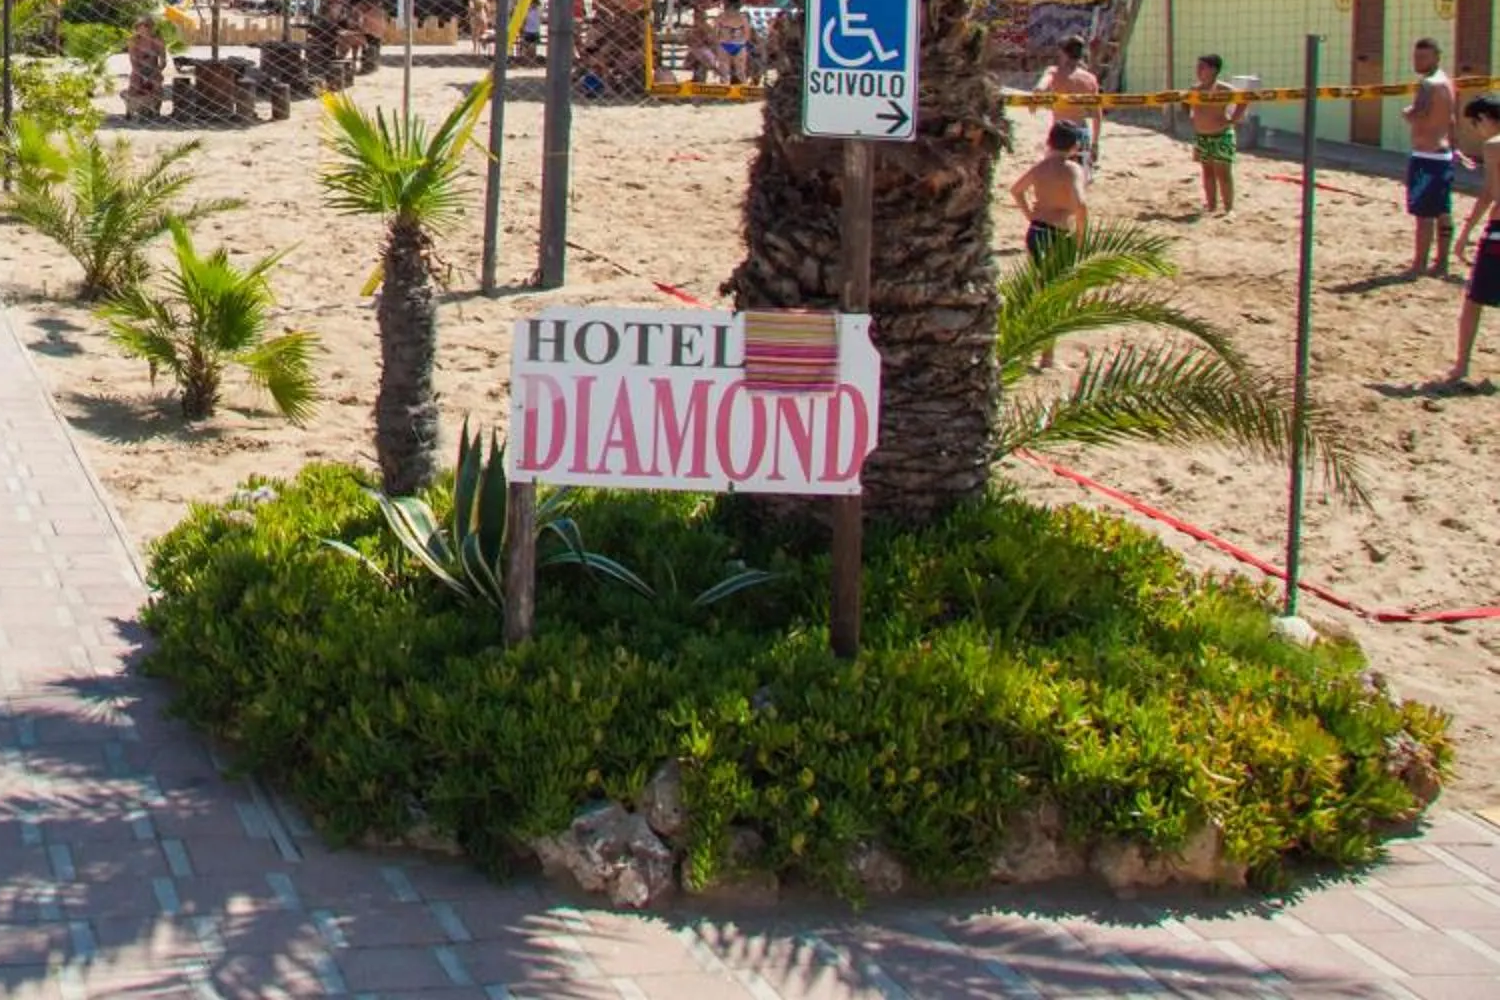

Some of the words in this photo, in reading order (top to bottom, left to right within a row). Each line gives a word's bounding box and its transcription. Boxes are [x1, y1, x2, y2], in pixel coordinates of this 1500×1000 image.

[809, 71, 905, 98] SCIVOLO
[525, 318, 747, 369] HOTEL
[515, 373, 870, 484] DIAMOND
